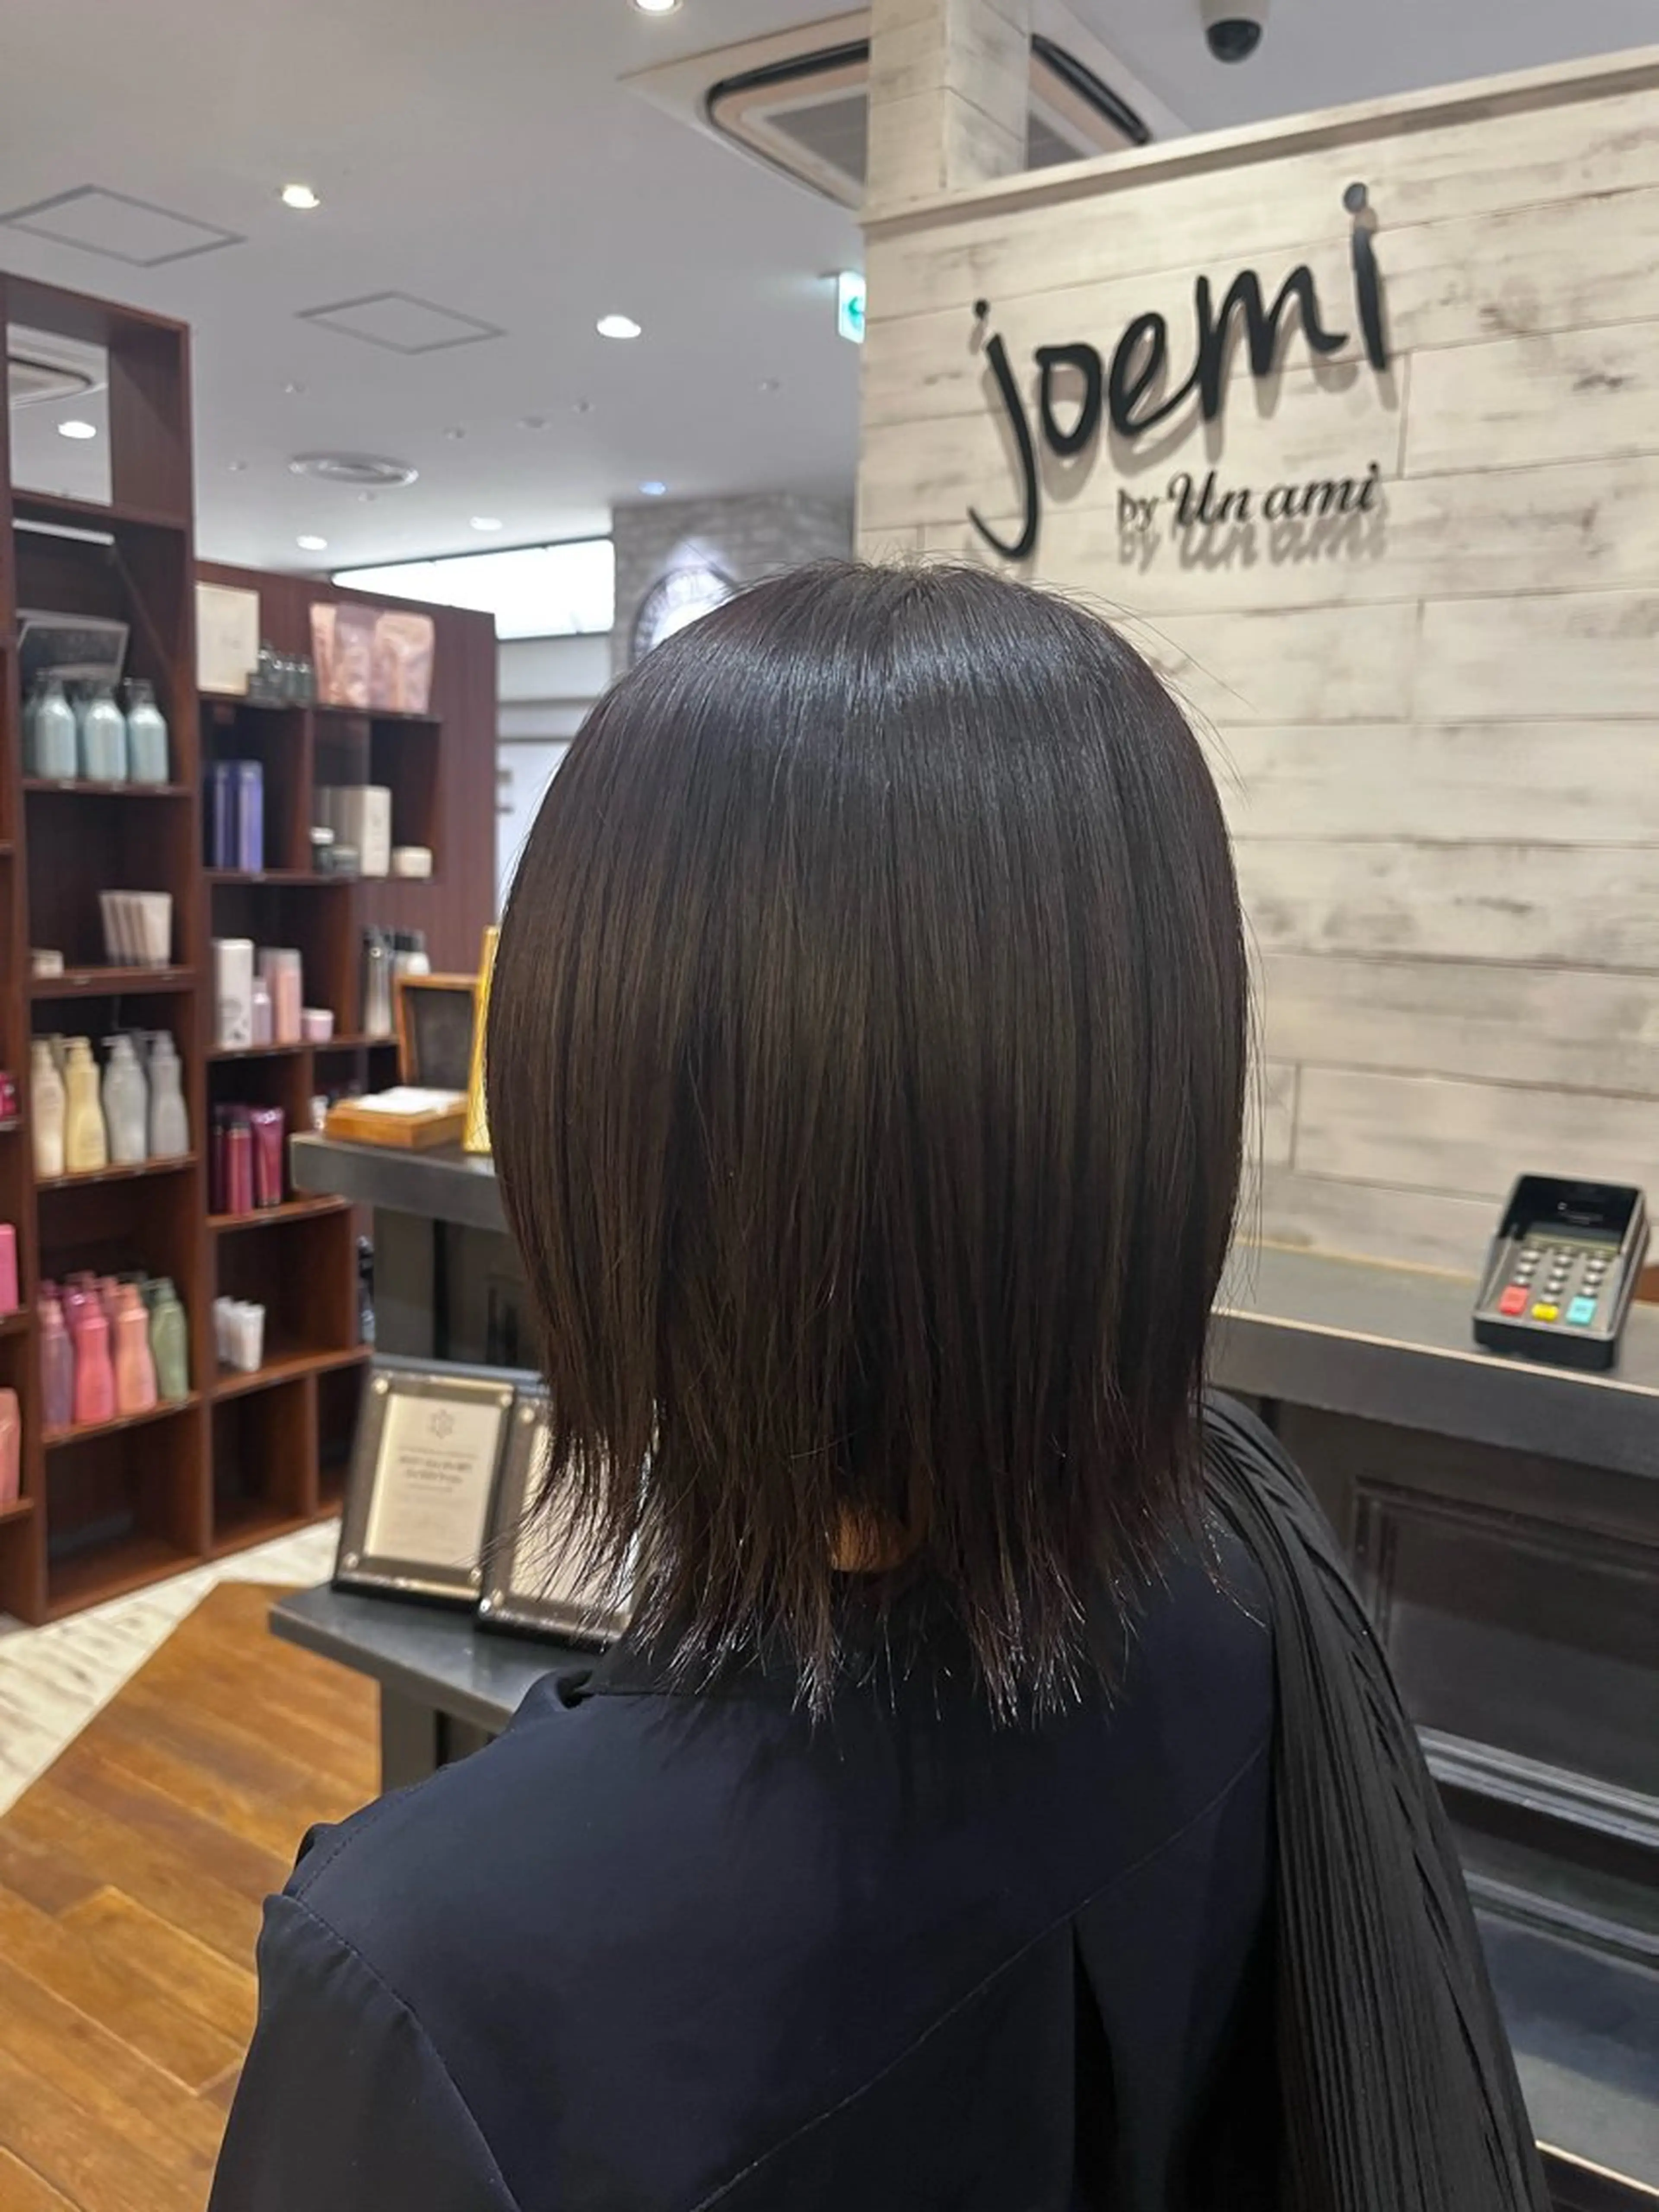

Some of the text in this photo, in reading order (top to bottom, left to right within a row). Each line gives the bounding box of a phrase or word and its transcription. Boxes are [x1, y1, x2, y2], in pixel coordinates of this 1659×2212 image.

[968, 182, 1389, 561] joemi
[1119, 461, 1379, 531] by Un ami
